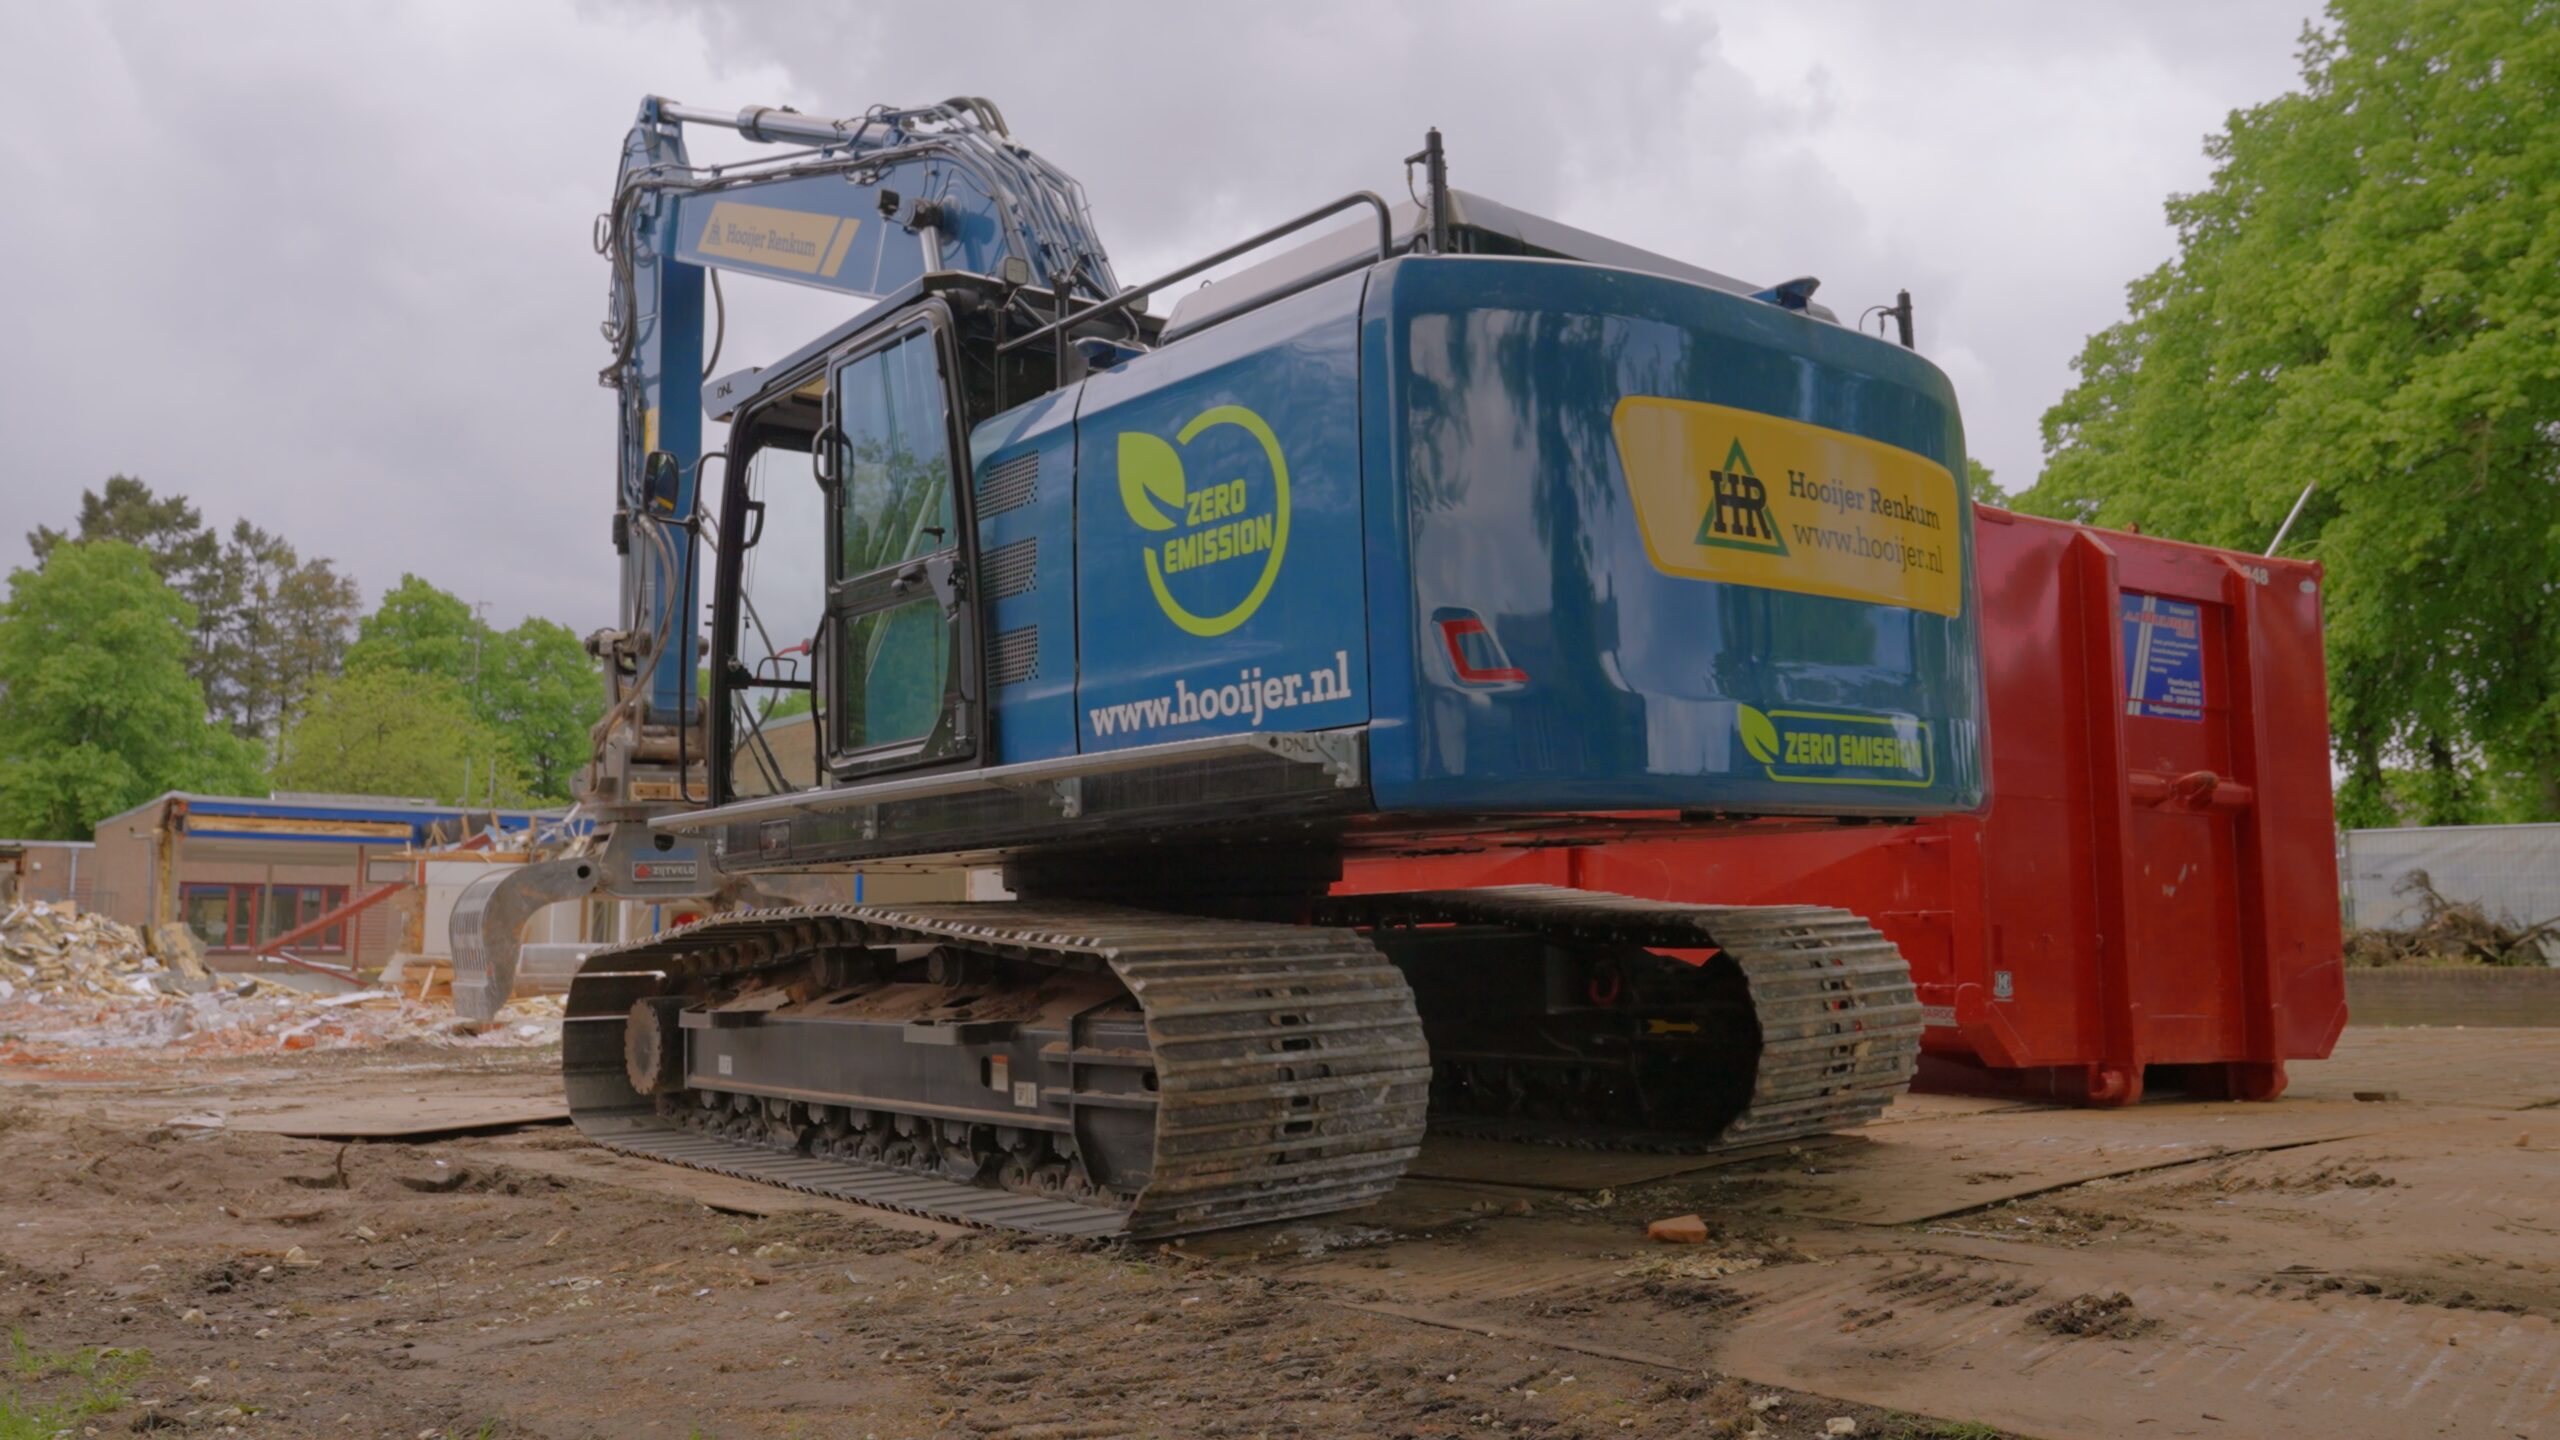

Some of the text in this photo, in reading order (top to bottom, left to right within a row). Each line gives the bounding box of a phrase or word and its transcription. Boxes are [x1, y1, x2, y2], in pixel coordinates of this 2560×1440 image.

[726, 223, 764, 253] Hooijer
[768, 229, 816, 257] Renkum
[1186, 478, 1246, 527] ZERO
[1710, 469, 1771, 540] HR
[1788, 470, 1941, 530] Hooijer Renkum
[1164, 513, 1273, 574] EMISSION
[1792, 524, 1944, 574] www.hooijer.nl
[1090, 650, 1352, 736] www.hooijer.nl
[1784, 731, 1836, 765] ZERO
